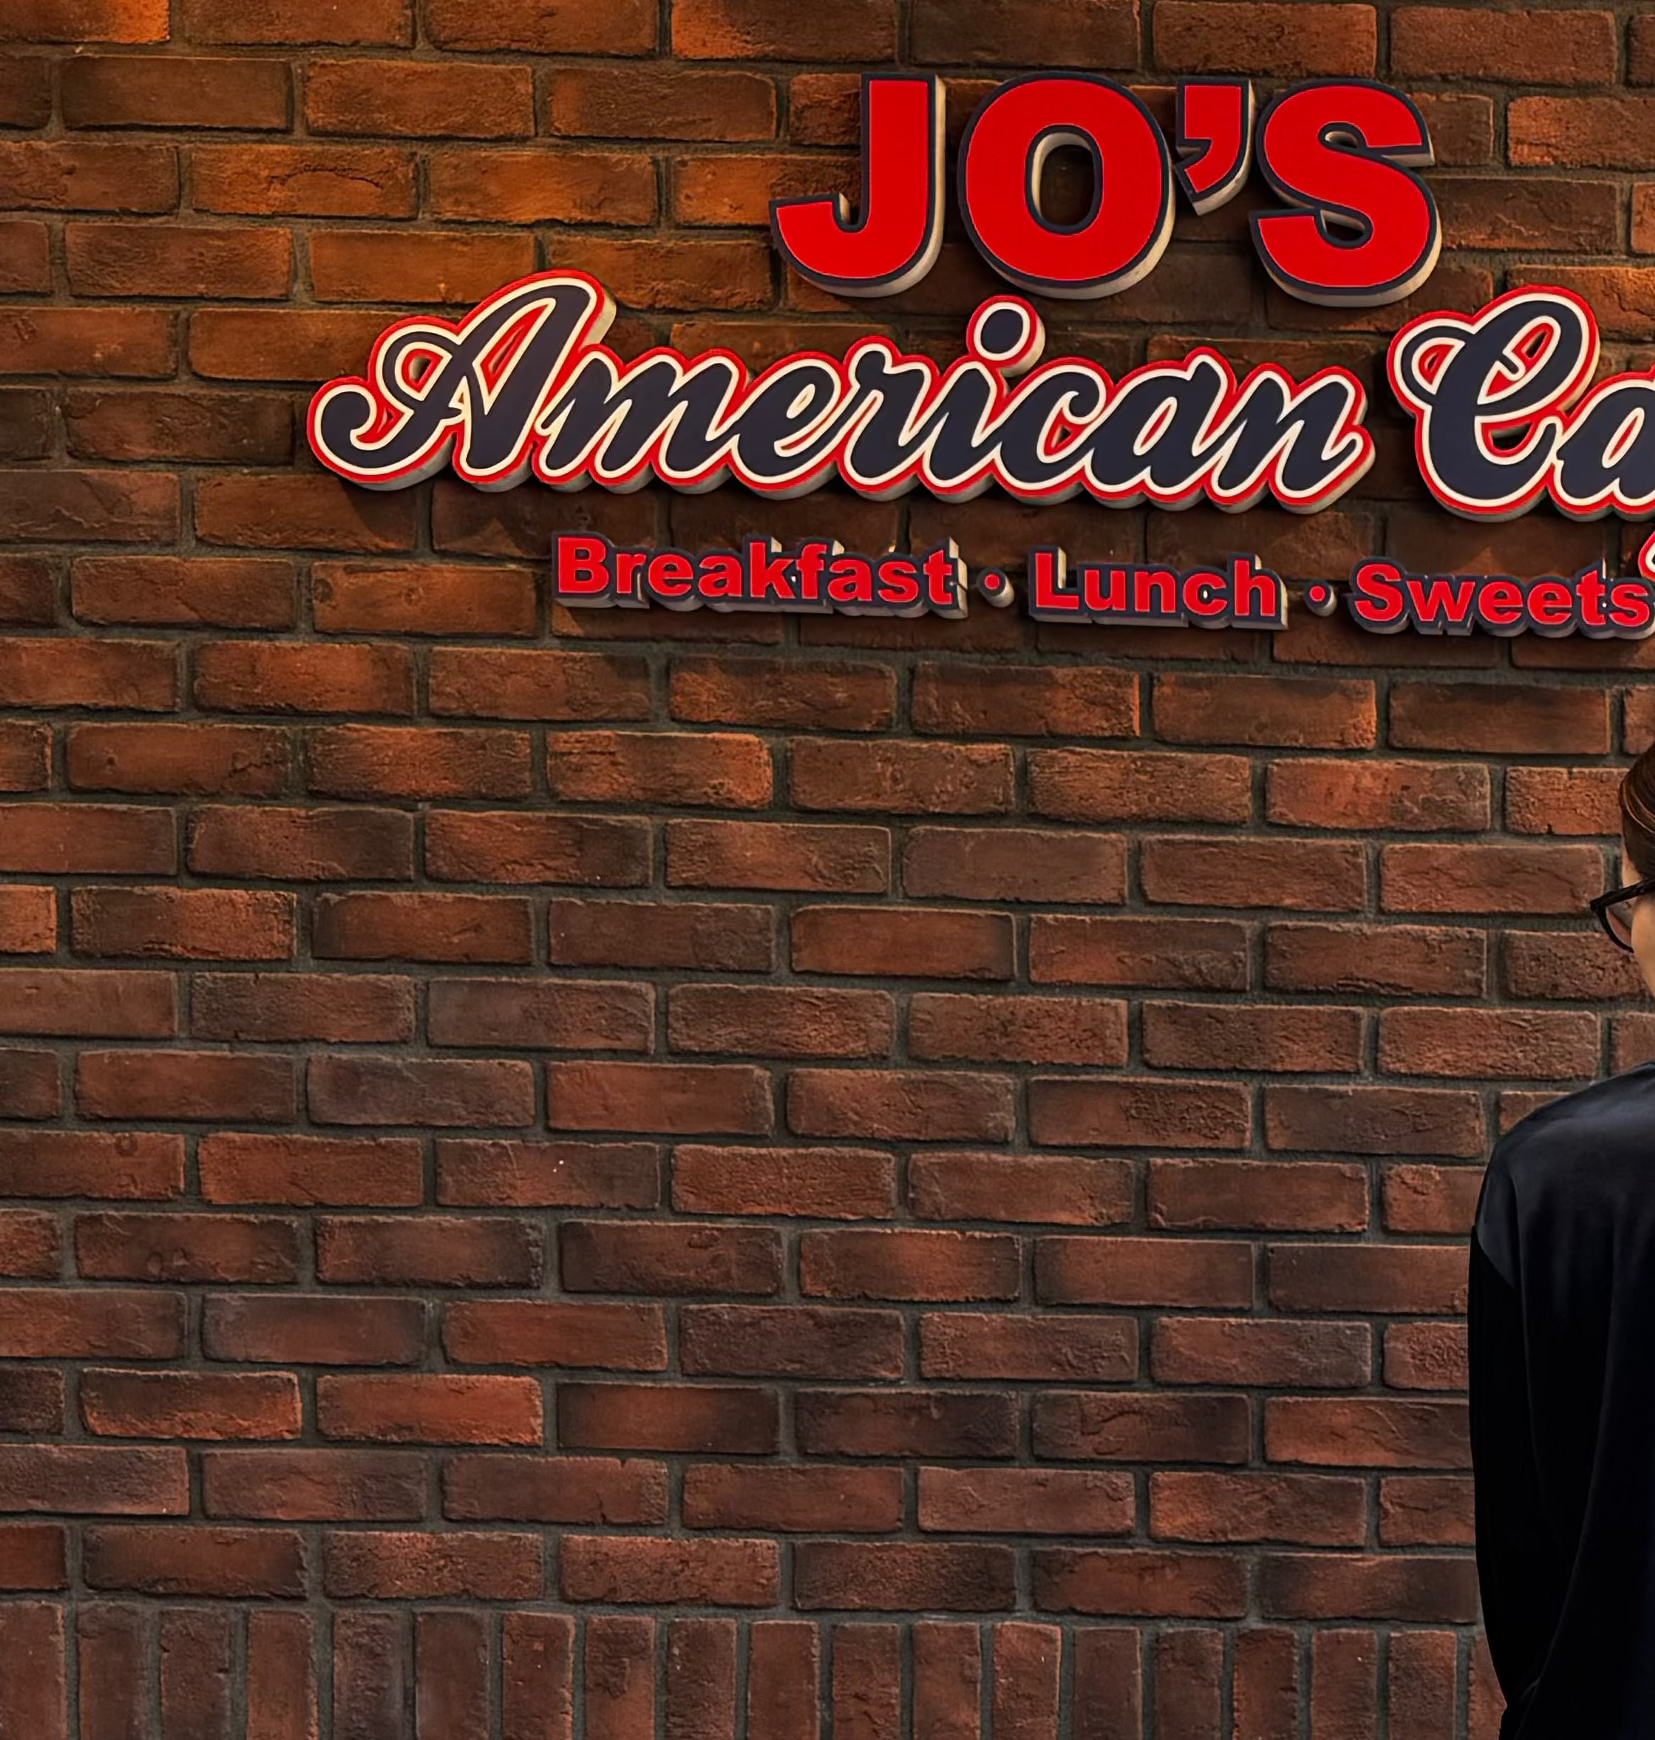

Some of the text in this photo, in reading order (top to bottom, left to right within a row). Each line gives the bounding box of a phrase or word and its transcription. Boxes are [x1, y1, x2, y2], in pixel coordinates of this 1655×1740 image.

[308, 268, 1373, 511] American
[552, 531, 965, 617] Breakfast
[1029, 546, 1286, 627] Lunch
